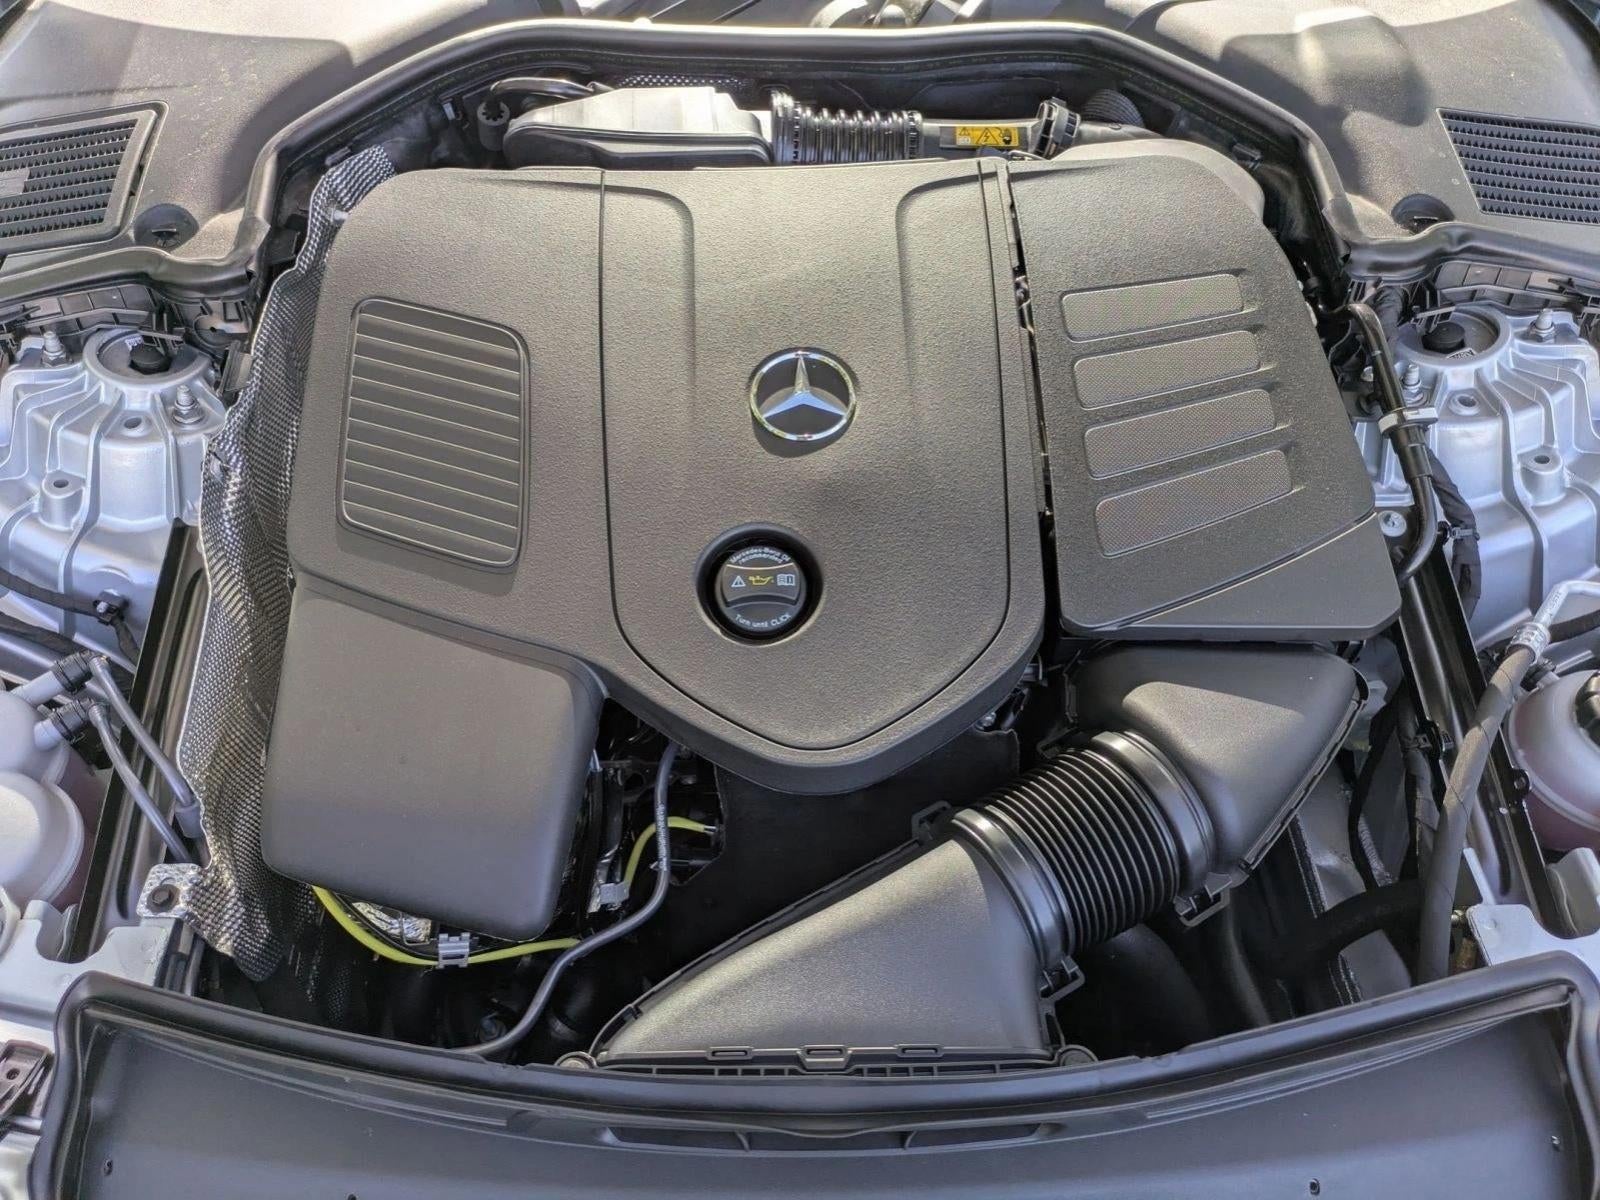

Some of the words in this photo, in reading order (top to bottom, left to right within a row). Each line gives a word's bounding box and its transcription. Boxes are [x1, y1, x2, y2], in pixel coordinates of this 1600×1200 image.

[729, 547, 781, 563] Mercedes-Benz
[735, 614, 751, 626] Turn
[770, 613, 791, 626] CLICK
